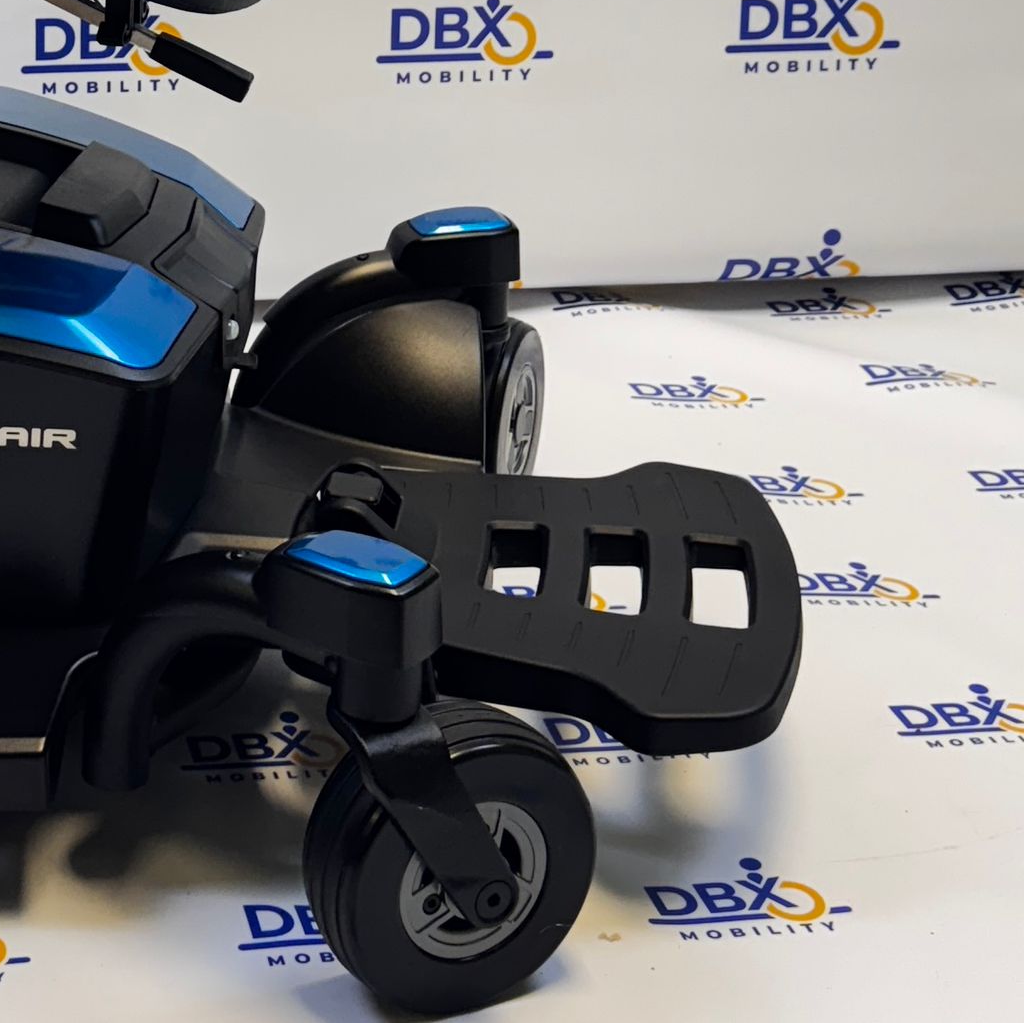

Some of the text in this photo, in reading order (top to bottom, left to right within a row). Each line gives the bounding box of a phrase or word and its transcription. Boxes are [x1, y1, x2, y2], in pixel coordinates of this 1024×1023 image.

[390, 5, 513, 50] DBX
[744, 58, 877, 73] MOBILITY
[42, 77, 180, 94] MOBILITY
[396, 68, 531, 84] MOBILITY
[628, 382, 730, 398] DBX
[807, 599, 929, 609] MOBILITY
[888, 699, 1024, 729] DBX
[186, 730, 321, 763] DBX
[645, 872, 798, 915] DBX
[680, 920, 838, 941] MOBILITY
